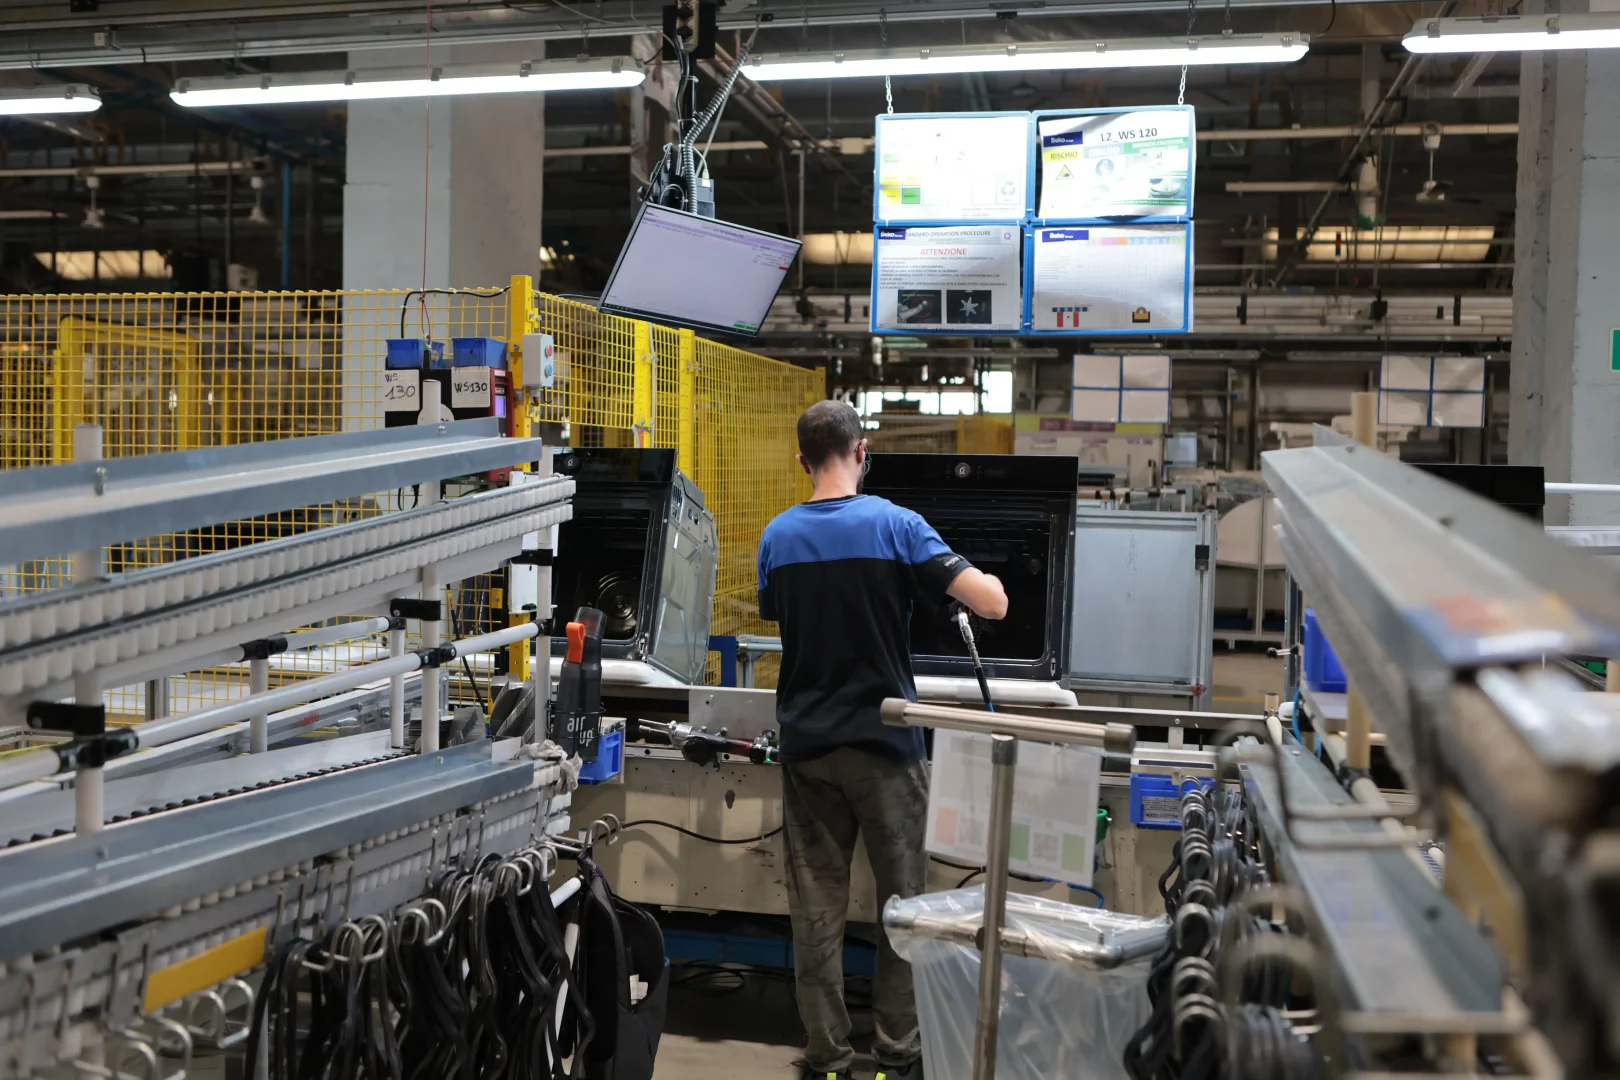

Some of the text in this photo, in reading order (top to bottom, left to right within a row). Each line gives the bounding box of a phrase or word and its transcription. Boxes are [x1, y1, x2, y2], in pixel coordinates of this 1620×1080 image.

[1100, 127, 1158, 143] L2_WS 120
[1050, 151, 1078, 160] RISCHIO
[384, 373, 398, 382] WS
[384, 385, 416, 400] 130
[567, 716, 586, 732] air
[579, 729, 593, 747] up
